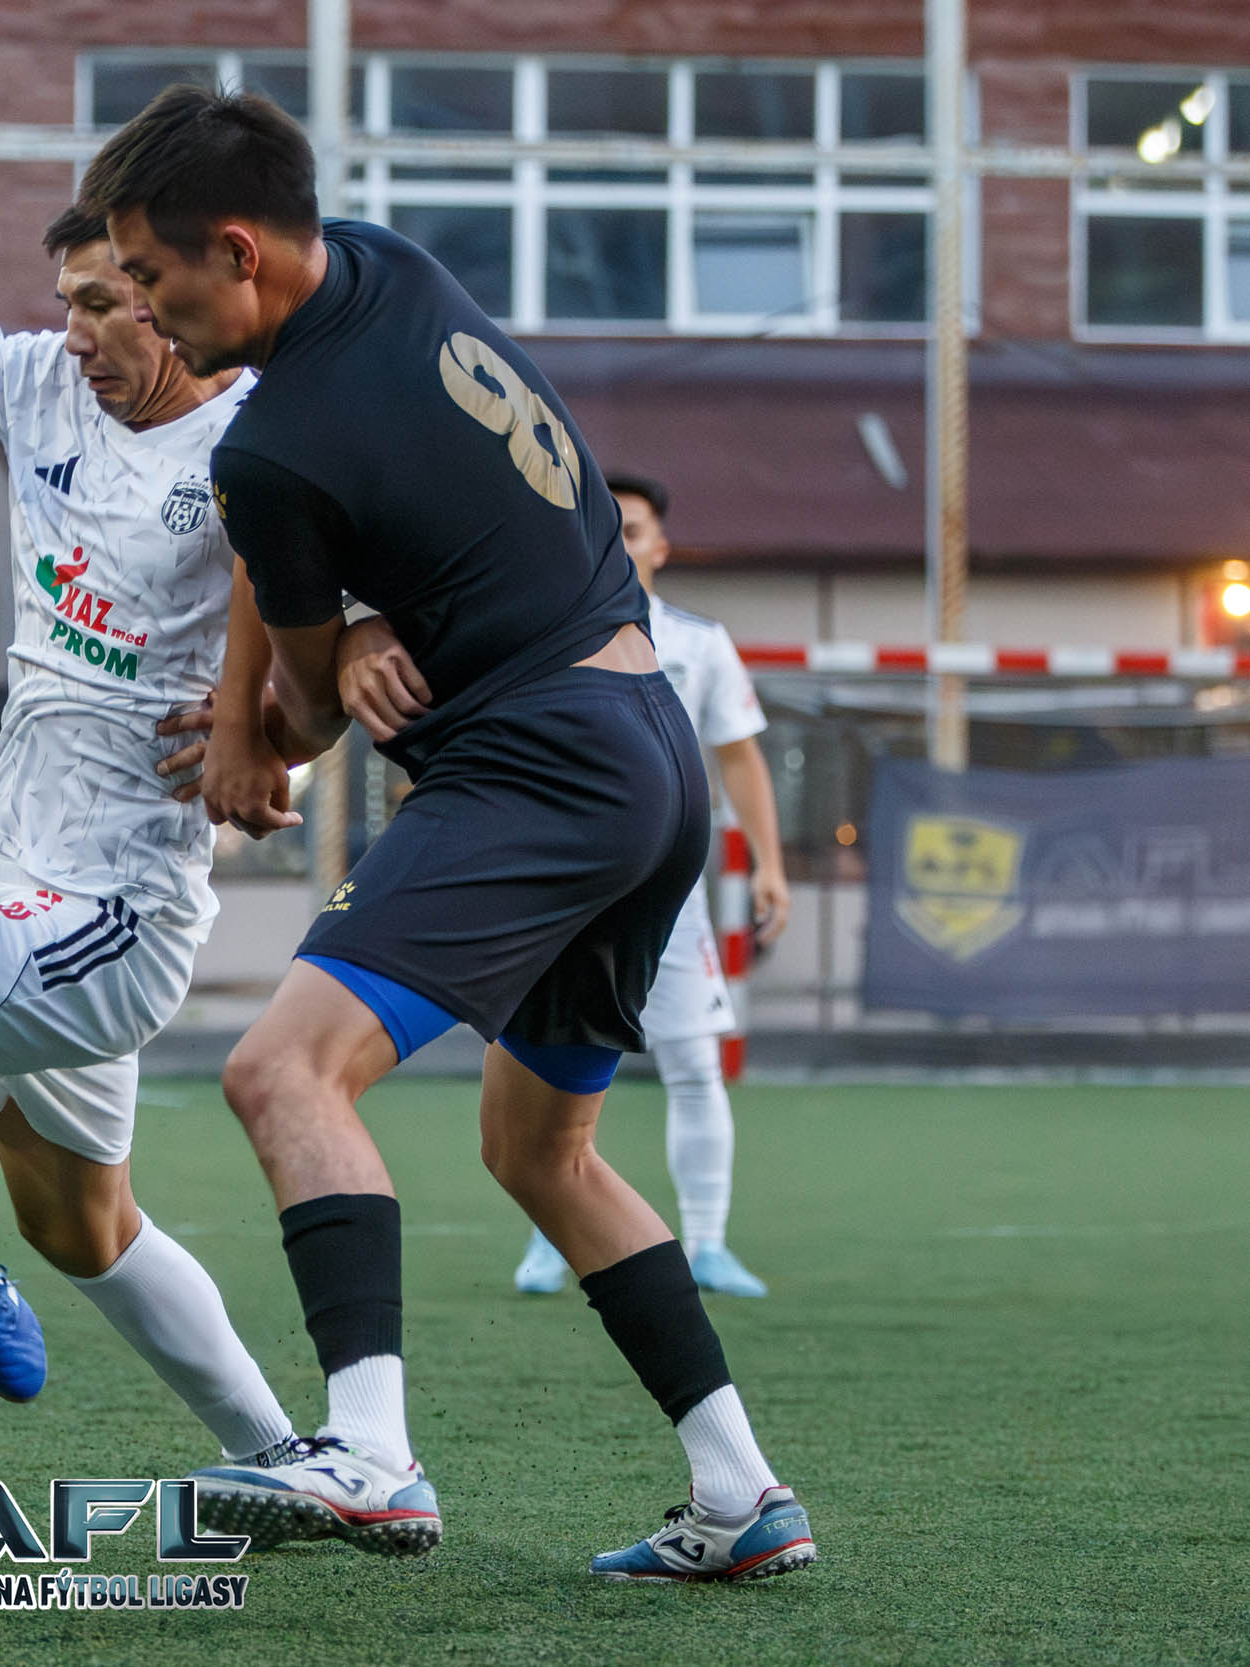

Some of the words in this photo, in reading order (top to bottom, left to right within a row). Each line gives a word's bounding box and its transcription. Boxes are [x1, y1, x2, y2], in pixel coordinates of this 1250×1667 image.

[439, 332, 581, 510] 8
[55, 584, 114, 635] KAZ
[111, 628, 148, 647] med
[49, 620, 138, 681] PROM
